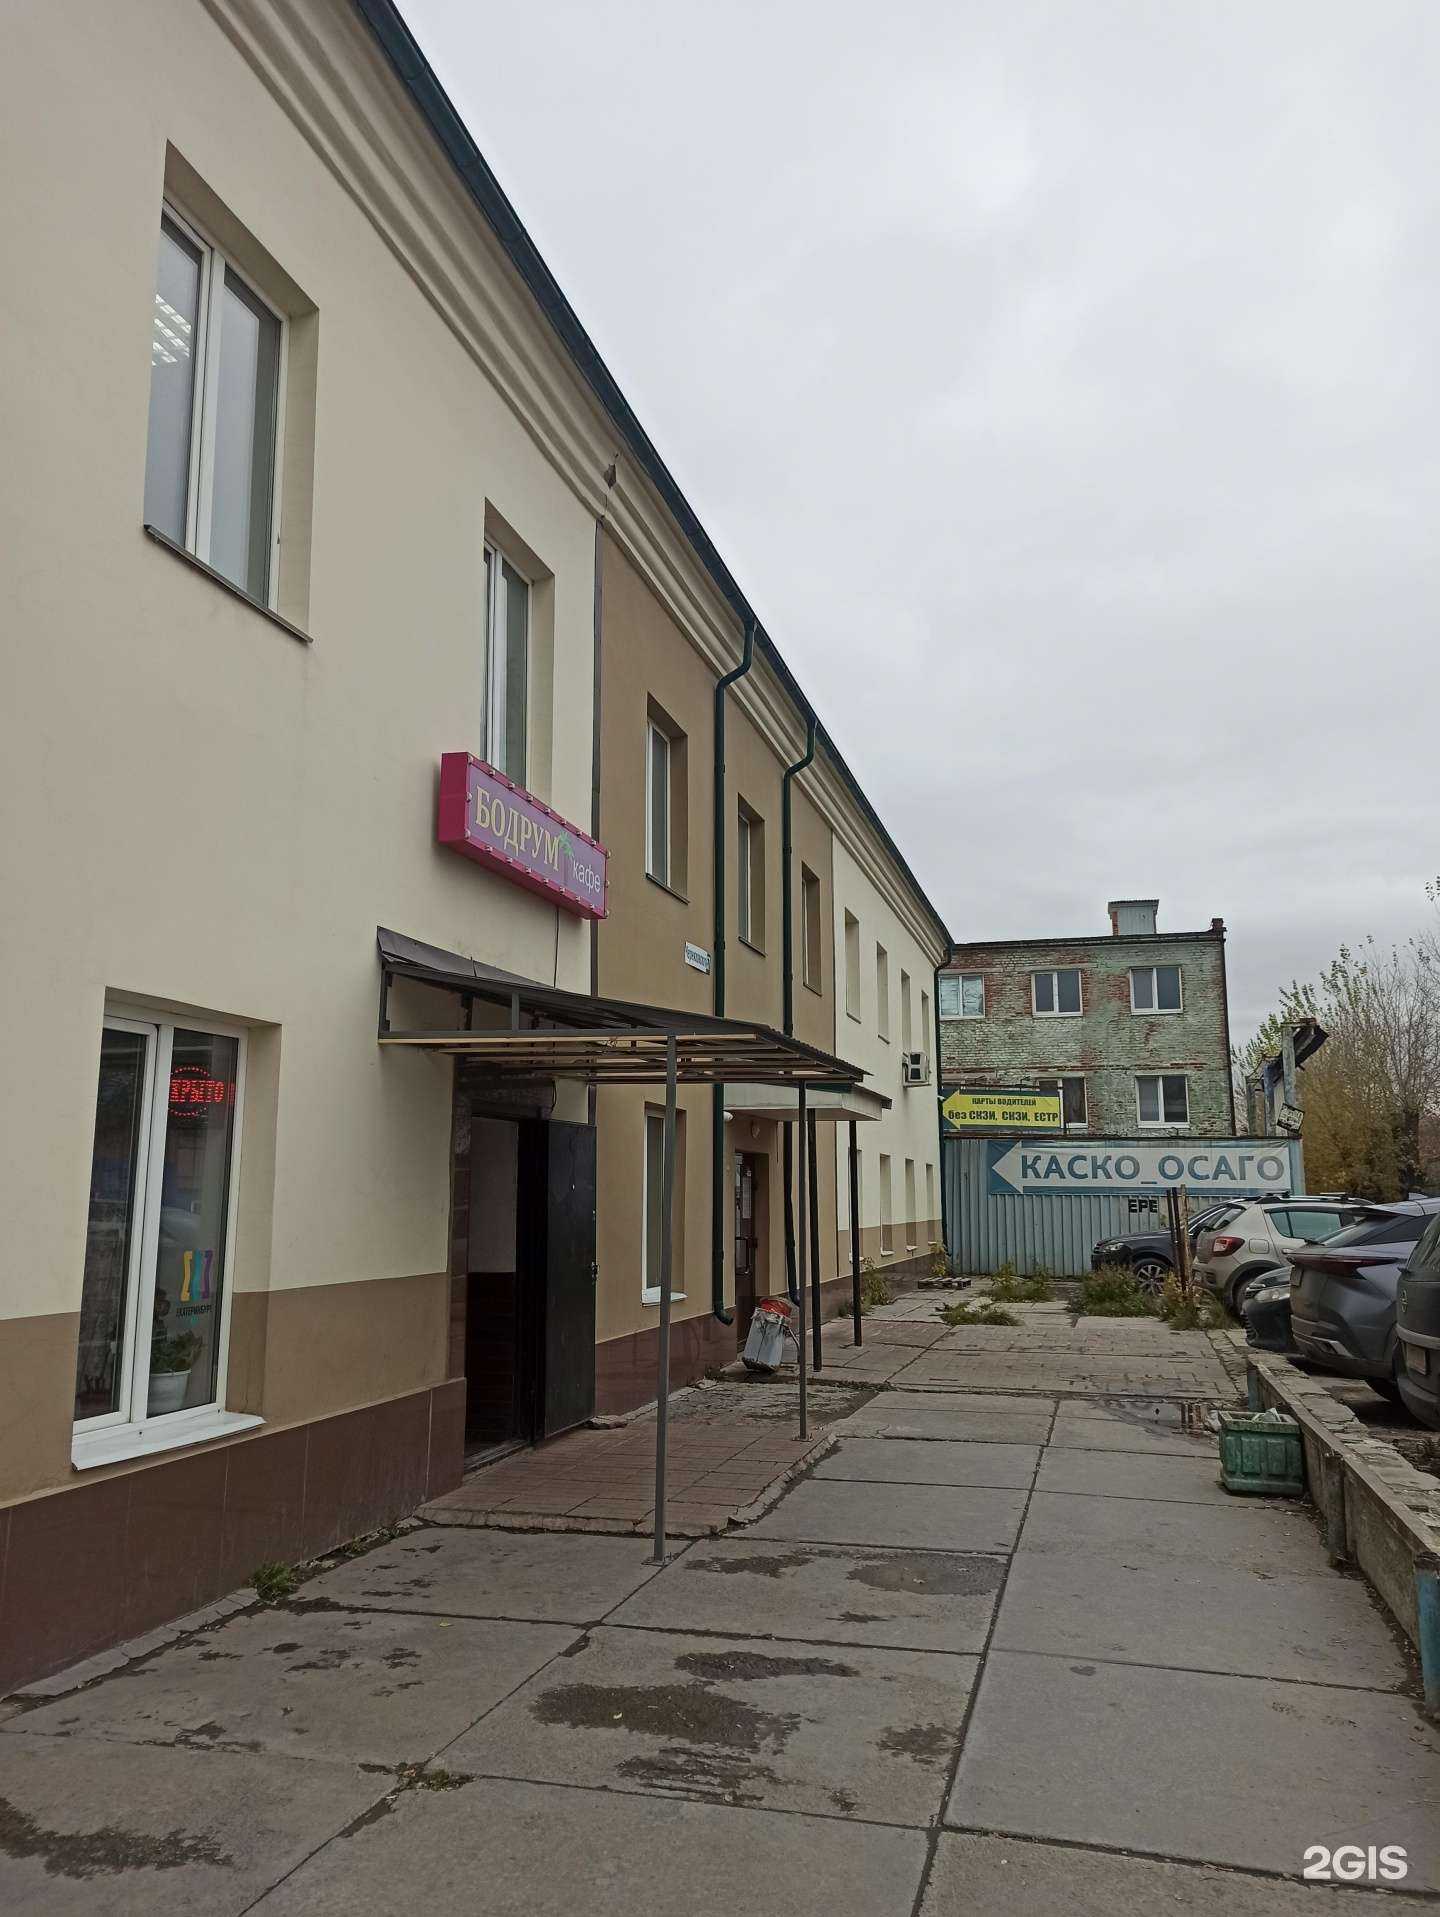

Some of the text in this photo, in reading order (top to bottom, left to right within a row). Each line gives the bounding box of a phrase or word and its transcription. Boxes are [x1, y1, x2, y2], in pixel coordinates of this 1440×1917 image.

[475, 784, 601, 895] БОДРУМ кафе
[997, 1097, 1037, 1106] ВОДИТЕЛЕЙ
[948, 1110, 967, 1120] без
[1034, 1112, 1059, 1122] ЕСТР
